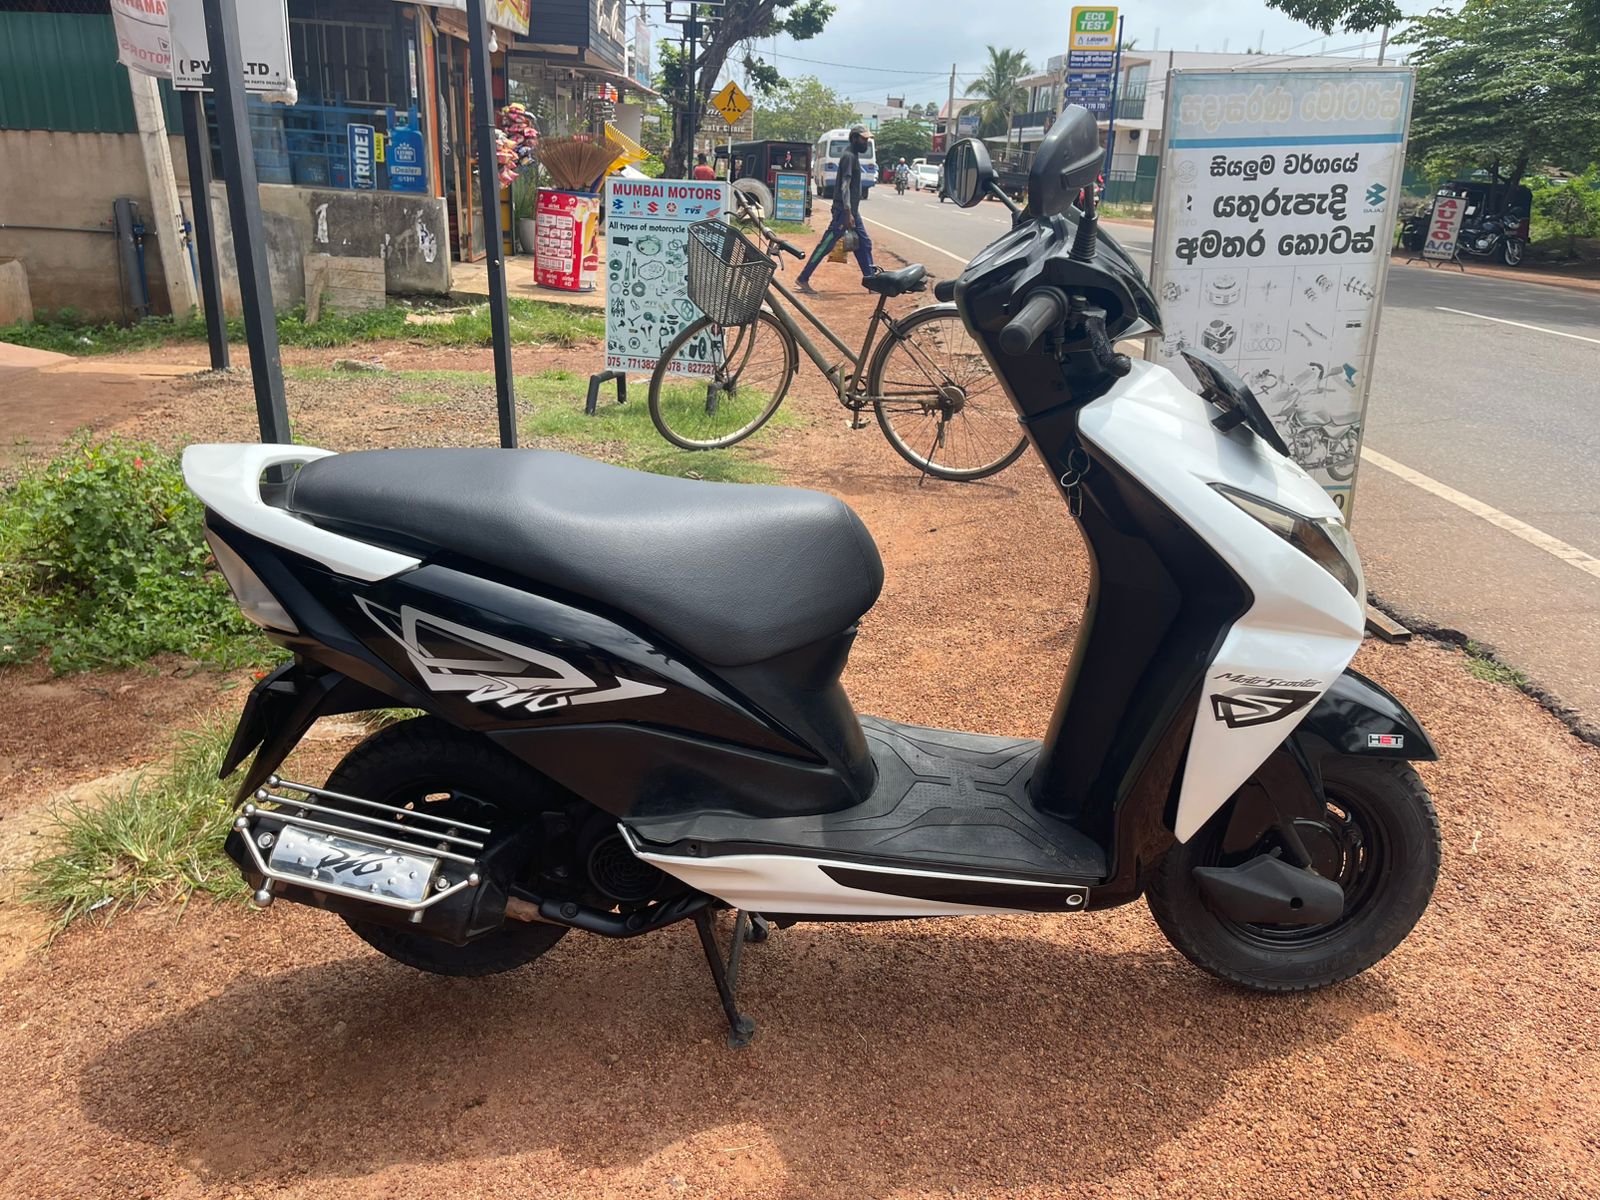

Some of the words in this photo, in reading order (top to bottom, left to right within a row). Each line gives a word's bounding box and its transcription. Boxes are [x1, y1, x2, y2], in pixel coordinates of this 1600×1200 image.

[1084, 12, 1106, 20] ECO
[1080, 21, 1109, 30] TEST
[1209, 154, 1276, 181] සියලුම
[1283, 152, 1360, 175] වර්ගයේ
[613, 183, 664, 197] MUMBAI
[668, 186, 721, 200] MOTORS
[1213, 183, 1348, 223] යතුරුපැදි
[1431, 200, 1457, 240] AUTO
[608, 221, 618, 229] All
[620, 222, 638, 231] types
[640, 222, 647, 231] of
[648, 224, 685, 234] motorcycle
[1175, 228, 1266, 265] අමතර
[1278, 225, 1376, 257] කොටස්
[1426, 240, 1453, 251] A/C
[628, 358, 657, 369] 771382
[688, 363, 716, 375] 827227
[1213, 672, 1263, 685] Moto
[1264, 676, 1322, 687] Scooter
[1369, 735, 1402, 745] HET
